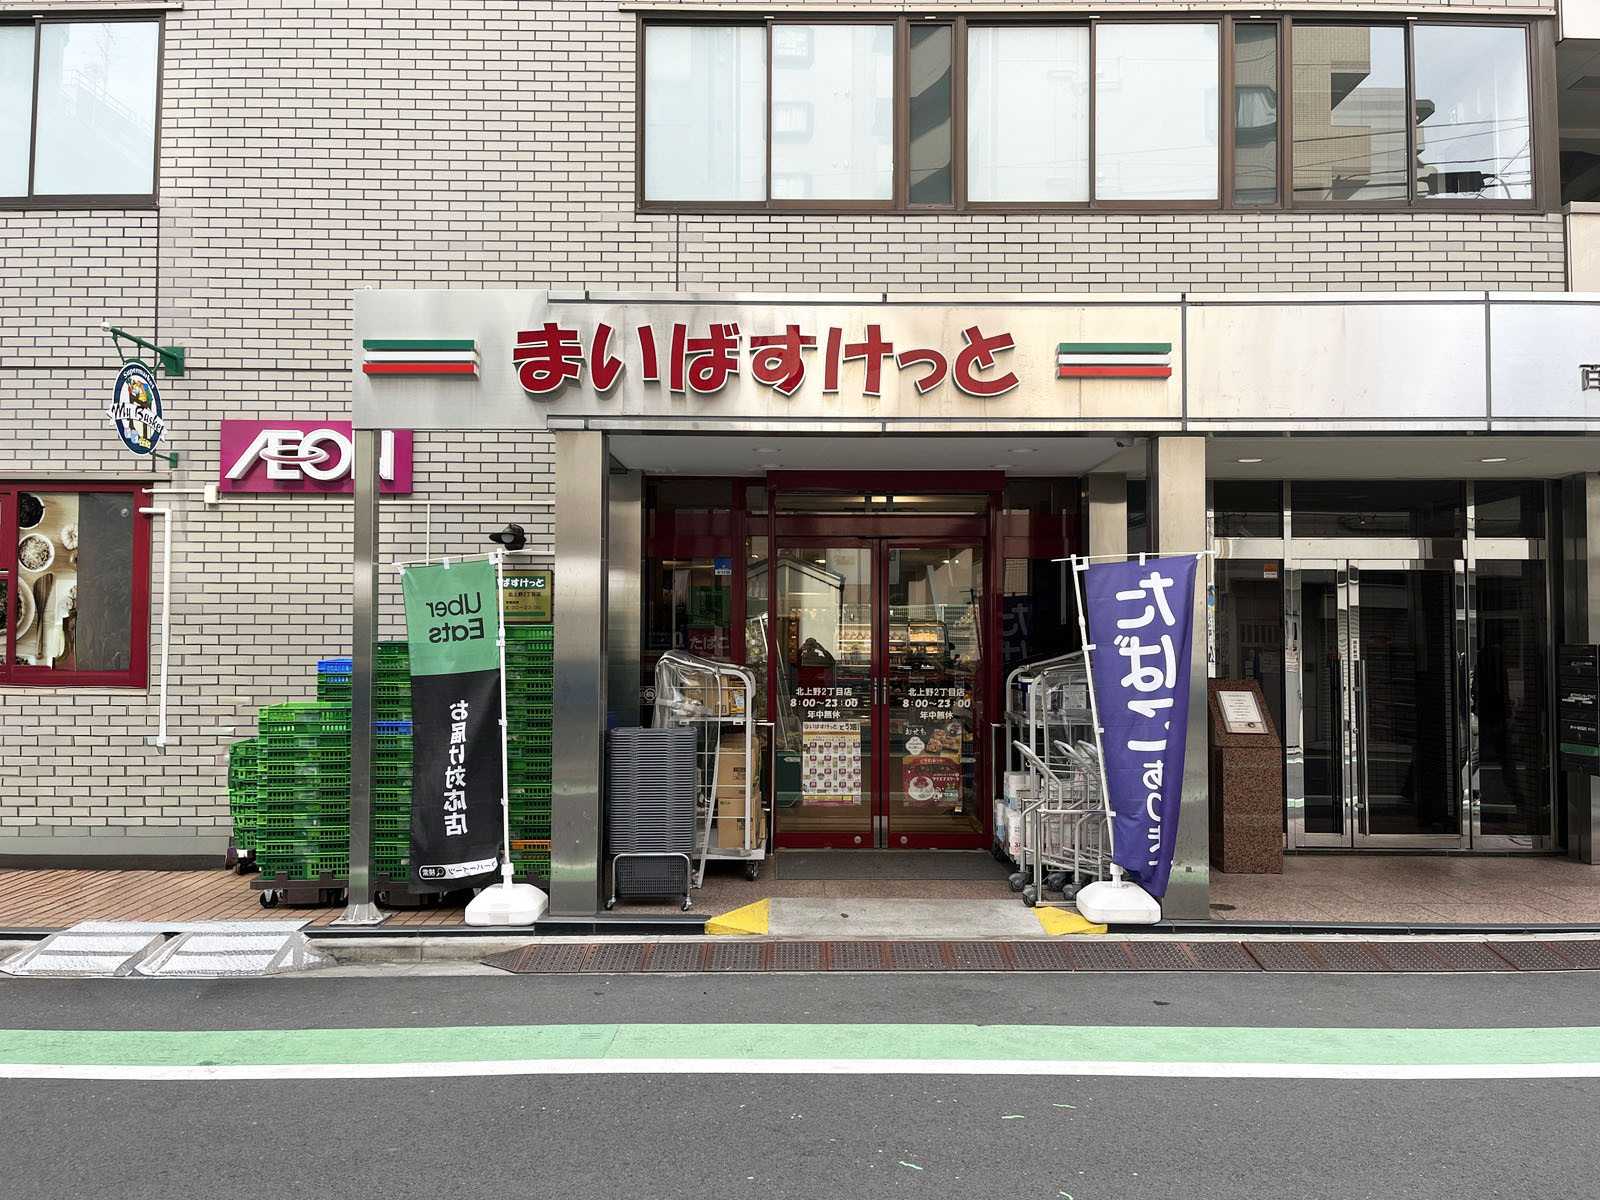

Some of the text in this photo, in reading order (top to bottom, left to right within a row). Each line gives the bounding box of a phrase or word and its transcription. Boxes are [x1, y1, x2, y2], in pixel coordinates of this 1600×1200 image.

[513, 323, 1021, 396] まいばすけっと
[796, 687, 852, 696] 北上野2丁目店
[908, 688, 965, 696] 北上野2丁目店
[808, 710, 840, 719] 年中無休
[920, 711, 953, 719] 年中無休
